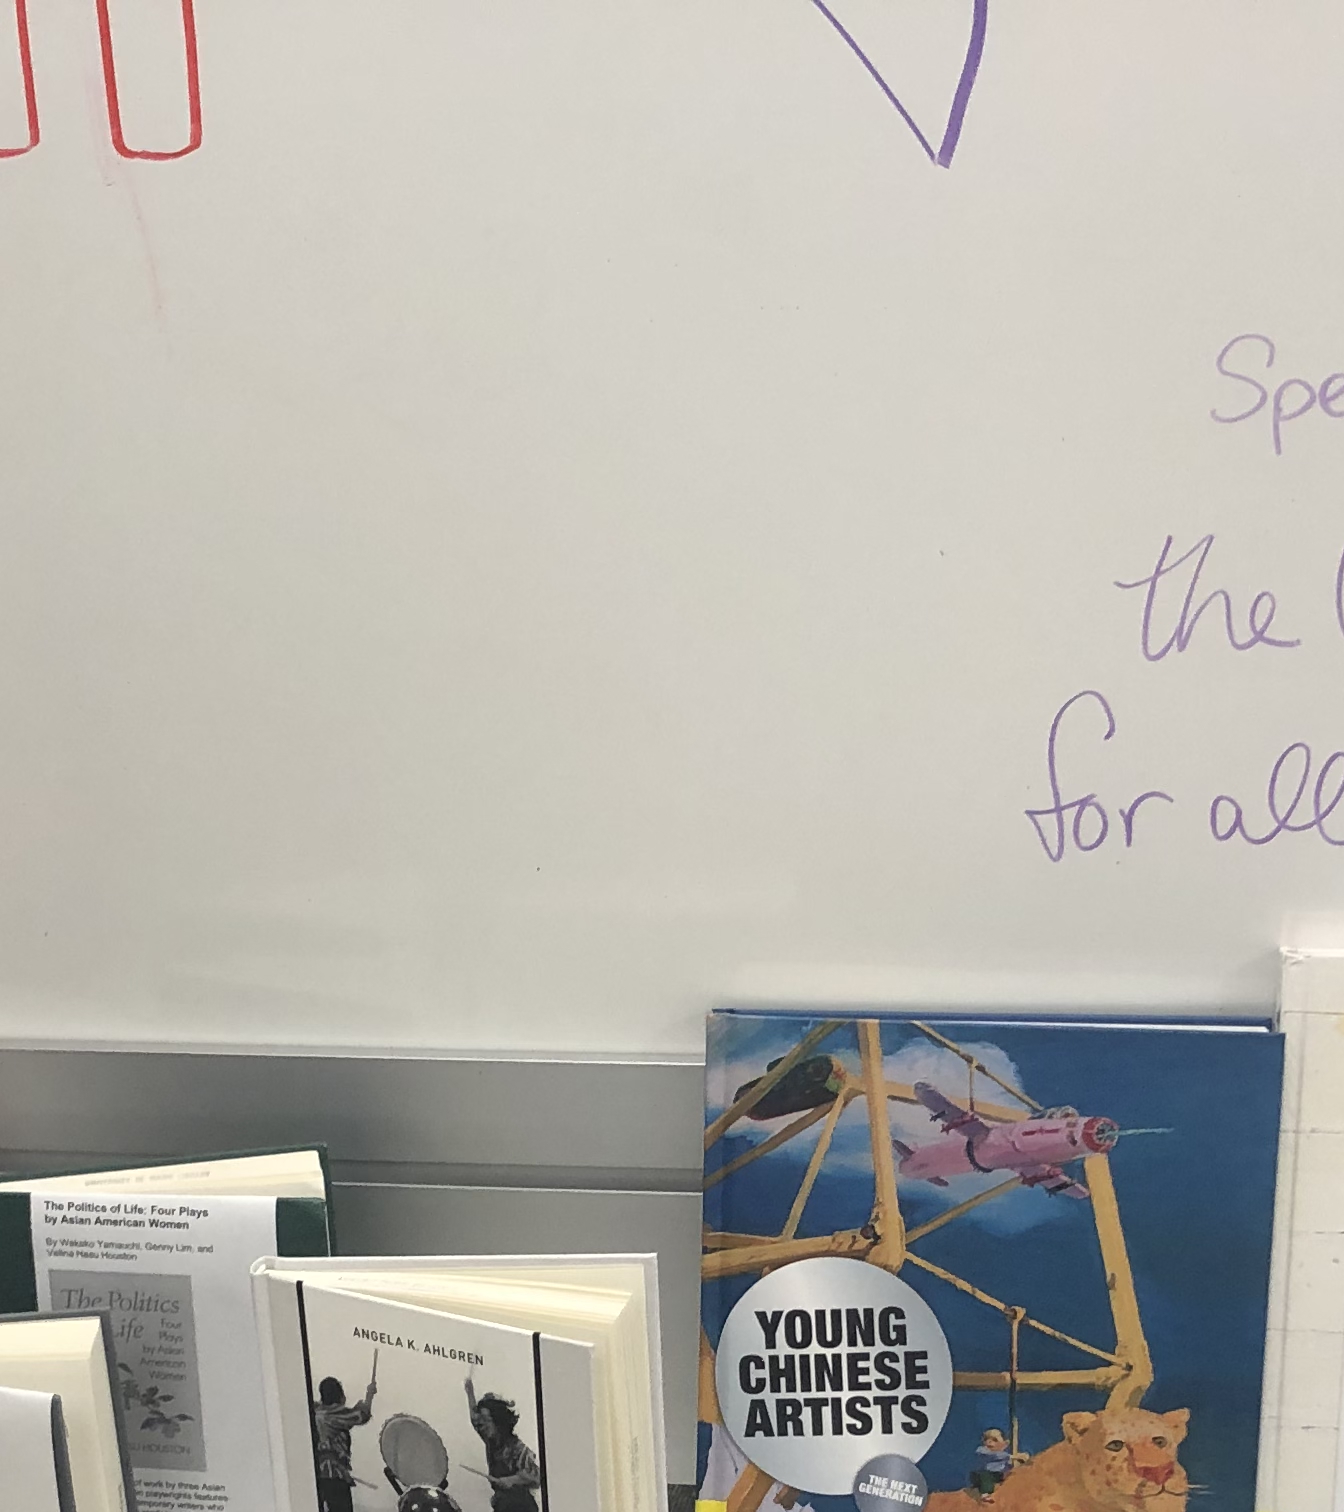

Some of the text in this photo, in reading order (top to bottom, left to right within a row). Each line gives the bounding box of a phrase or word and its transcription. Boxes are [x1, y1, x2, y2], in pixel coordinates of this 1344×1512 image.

[1115, 533, 1301, 662] the
[1025, 690, 1174, 862] for
[43, 1200, 209, 1220] The Politics of Life: Four Plays
[45, 1214, 190, 1230] by Asian American Women
[45, 1237, 58, 1248] By
[197, 1245, 214, 1254] and
[102, 1251, 138, 1261] Houston
[60, 1288, 181, 1314] The Politics
[754, 1306, 908, 1350] YOUNG
[352, 1326, 484, 1366] ANGELA K. AHLGREN
[139, 1357, 187, 1369] American
[148, 1370, 187, 1381] Women
[738, 1350, 930, 1395] CHINESE
[744, 1394, 929, 1438] ARTISTS
[858, 1482, 924, 1507] GENERATION
[868, 1474, 918, 1495] THE NEXT
